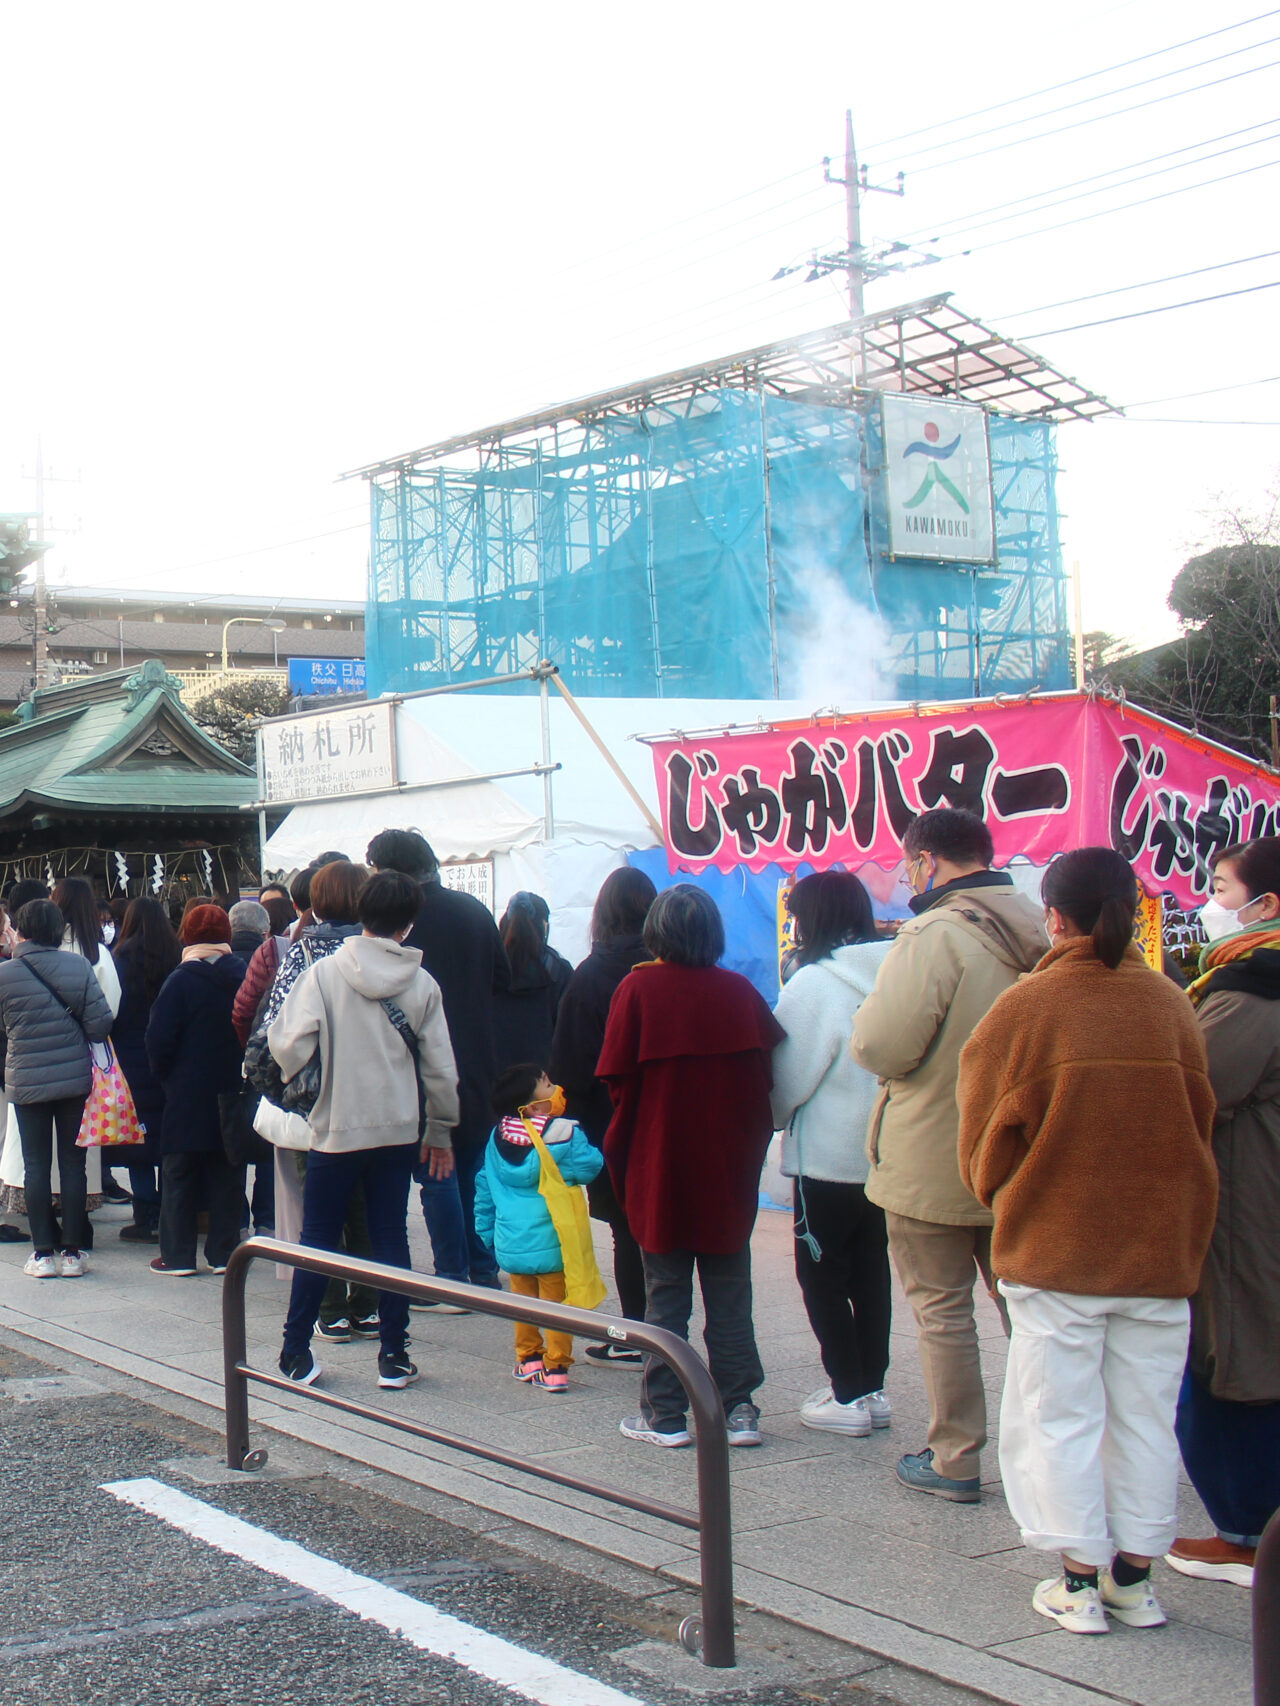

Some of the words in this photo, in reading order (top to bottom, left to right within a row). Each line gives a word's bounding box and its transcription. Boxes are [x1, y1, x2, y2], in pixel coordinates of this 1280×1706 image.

[905, 515, 968, 537] KAWAMOKU
[312, 663, 337, 676] 秩父
[342, 664, 366, 677] 日高
[279, 712, 376, 766] 納札所
[665, 724, 1071, 859] じゃがバター
